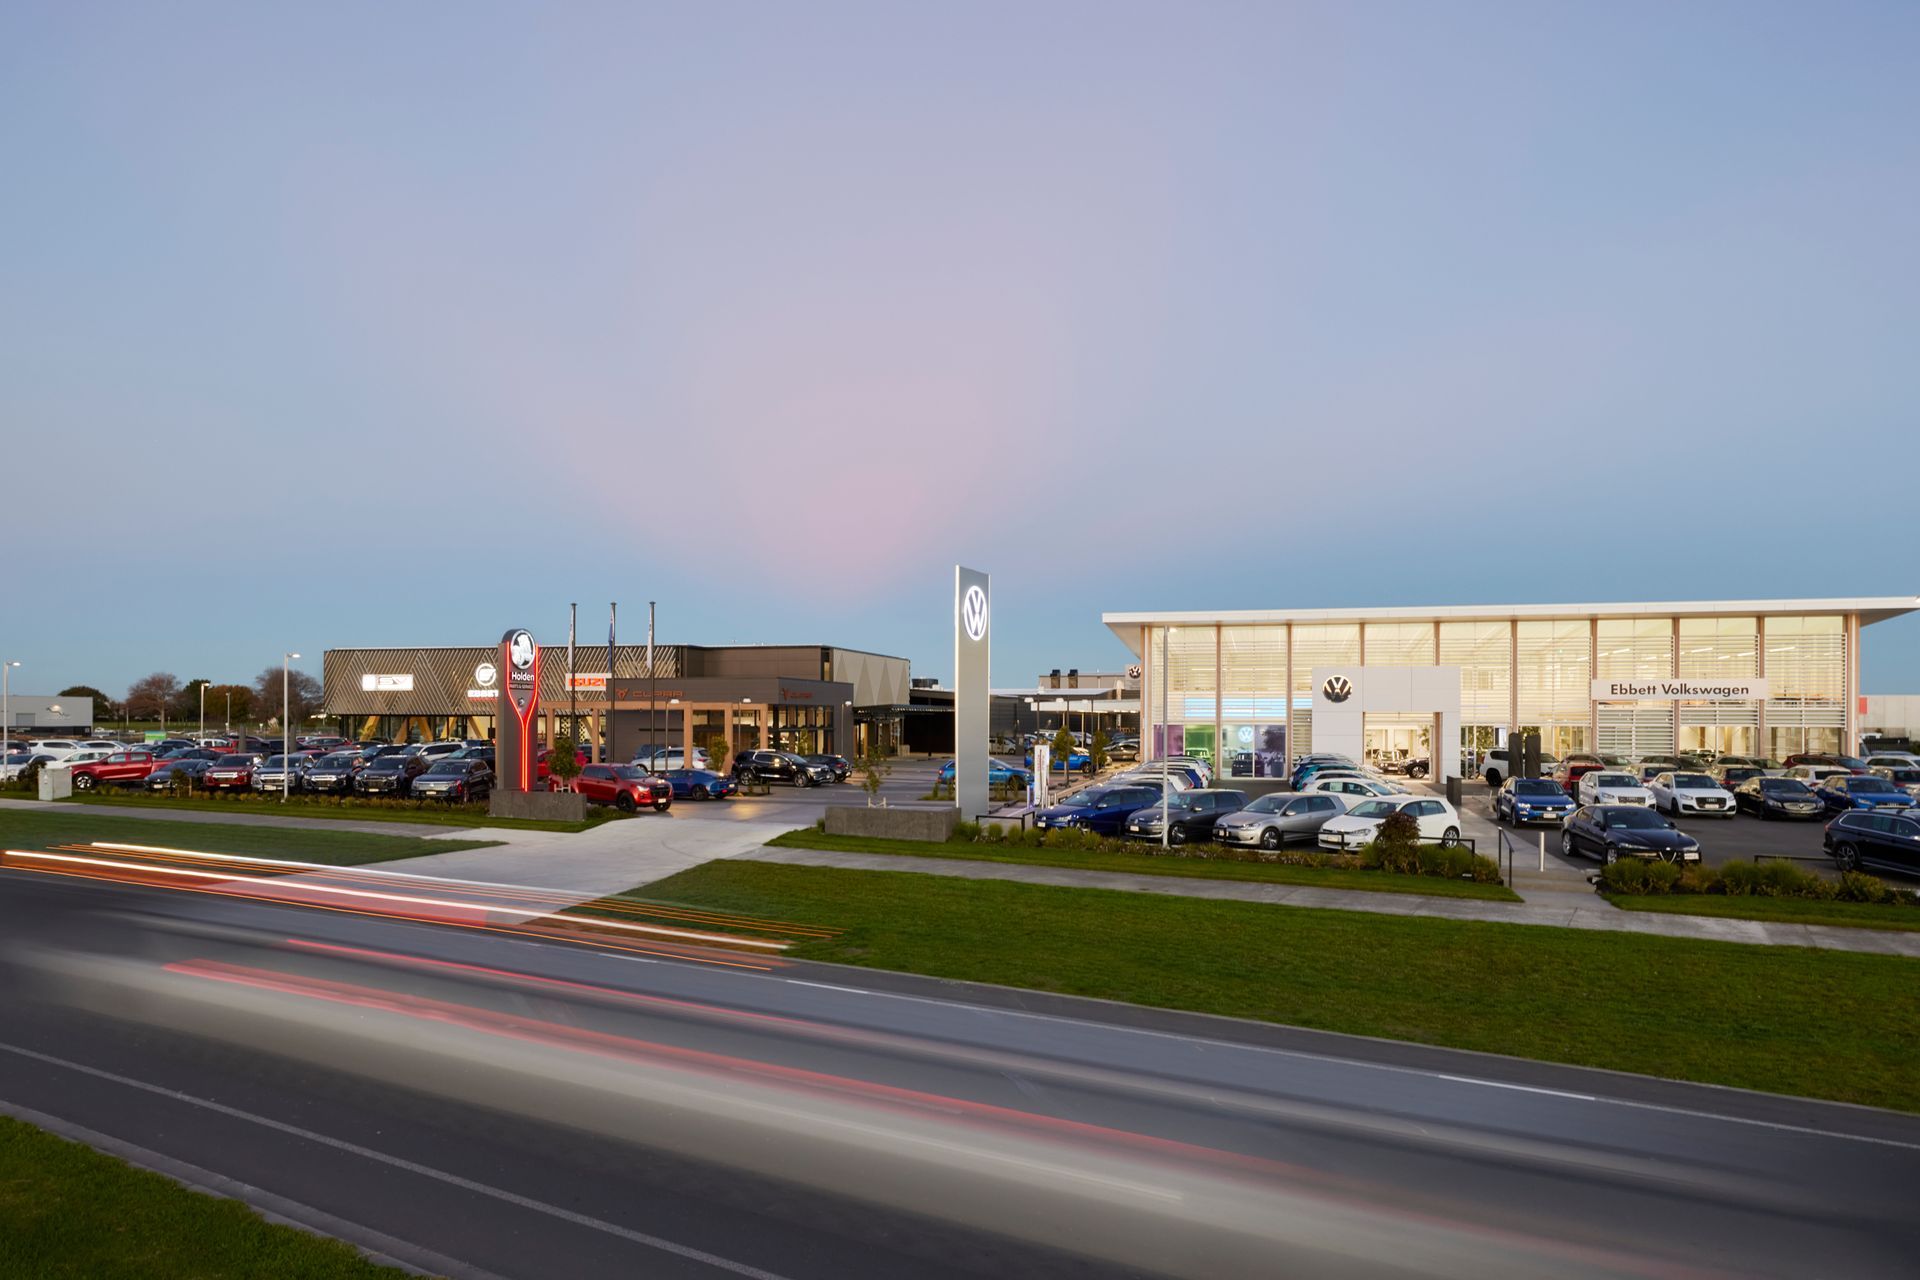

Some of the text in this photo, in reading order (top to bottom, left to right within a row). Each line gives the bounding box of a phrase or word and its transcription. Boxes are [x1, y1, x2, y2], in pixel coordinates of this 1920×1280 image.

[511, 671, 535, 681] Holden
[1610, 683, 1750, 698] Ebbett Volkswagen
